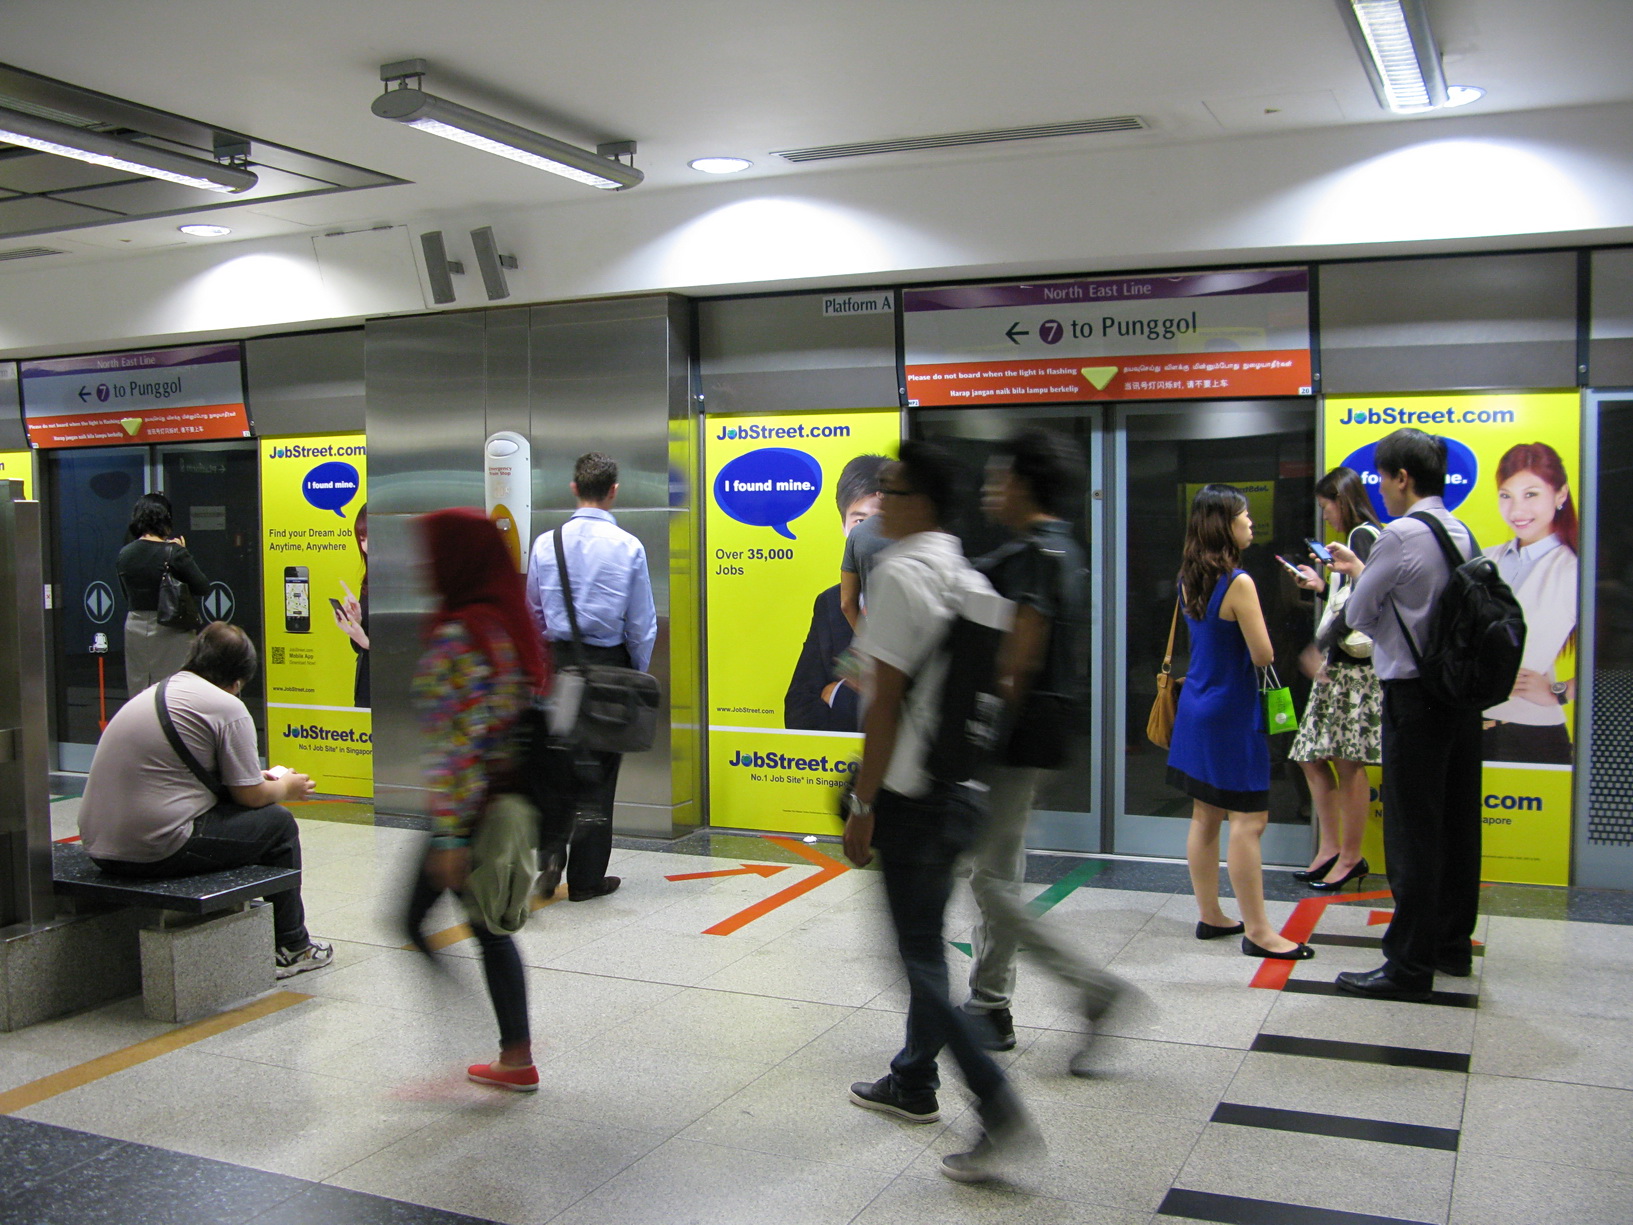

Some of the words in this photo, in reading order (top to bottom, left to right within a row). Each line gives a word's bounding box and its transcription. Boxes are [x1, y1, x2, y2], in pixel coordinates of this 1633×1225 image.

[1044, 286, 1083, 300] North
[1089, 284, 1118, 297] East
[1123, 282, 1151, 295] Line
[825, 297, 877, 313] Platform
[882, 296, 891, 310] A
[1044, 322, 1058, 342] 7
[1071, 319, 1093, 339] to
[1102, 311, 1197, 340] Punggol
[97, 359, 119, 370] North
[121, 358, 138, 367] East
[140, 356, 156, 365] Line
[907, 374, 931, 382] Please
[944, 372, 957, 380] not
[958, 371, 981, 379] board
[982, 370, 1003, 378] when
[1004, 369, 1017, 377] the
[1018, 368, 1037, 377] light
[1038, 367, 1045, 375] is
[1046, 367, 1078, 375] flashing
[98, 385, 108, 400] 7
[112, 384, 126, 399] to
[129, 376, 182, 399] Punggol
[971, 388, 995, 398] jangan
[995, 387, 1011, 395] naik
[1012, 386, 1025, 394] bila
[1026, 386, 1048, 395] lampu
[1049, 385, 1079, 394] berkelip
[1339, 406, 1515, 425] JobStreet.com
[716, 424, 851, 441] JobStreet.com
[269, 444, 367, 459] JobStreet.com
[307, 481, 311, 489] I
[312, 480, 334, 489] found
[335, 480, 356, 488] mine.
[724, 480, 730, 492] I
[733, 479, 773, 492] found
[776, 478, 816, 491] mine.
[269, 528, 286, 538] Find
[288, 529, 306, 539] your
[308, 528, 335, 537] Dream
[337, 528, 353, 537] Job
[269, 542, 304, 553] Anytime,
[306, 541, 347, 553] Anywhere
[715, 548, 743, 560] Over
[747, 548, 794, 562] 35,000
[715, 564, 744, 576] Jobs
[272, 685, 315, 693] www.JobStreet.com
[716, 706, 775, 714] www.JobStreet.com
[283, 723, 372, 744] JobStreet.c
[299, 743, 312, 751] No.1
[729, 750, 859, 773] JobStreet.co
[750, 773, 768, 782] No.1
[770, 775, 784, 783] Job
[806, 776, 814, 784] in
